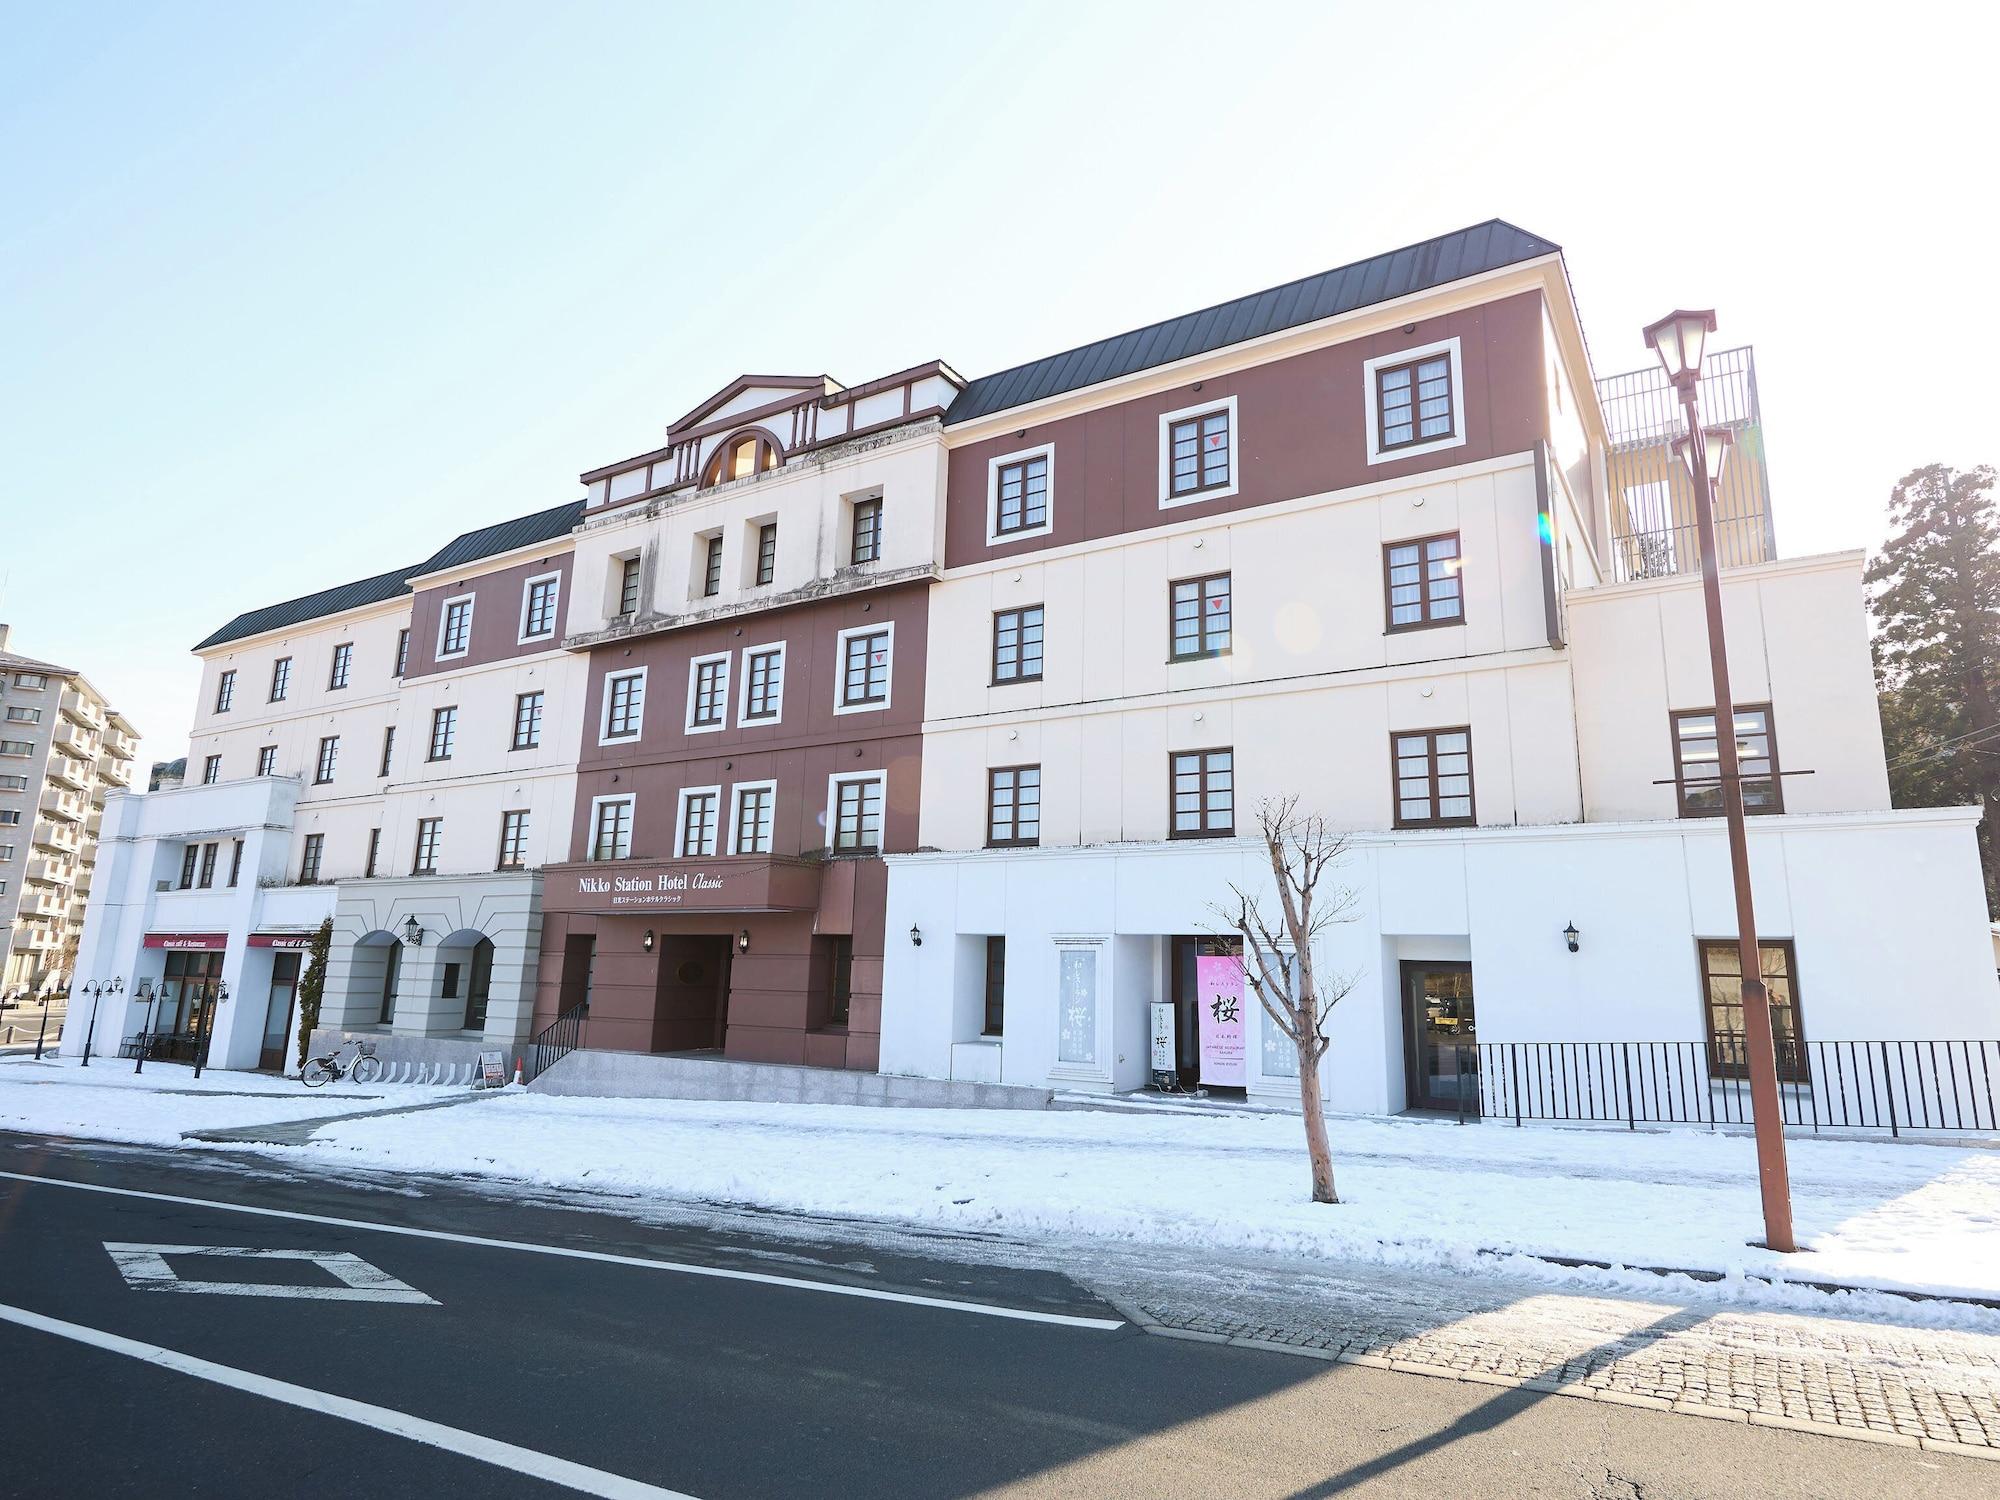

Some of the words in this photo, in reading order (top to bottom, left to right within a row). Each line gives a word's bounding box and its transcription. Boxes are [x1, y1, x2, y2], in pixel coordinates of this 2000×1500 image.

[579, 877, 611, 893] Nikko
[614, 876, 653, 892] Station
[658, 873, 688, 890] Hotel
[691, 872, 724, 889] Classic
[613, 895, 682, 905] 日光ステーションホテルクラシック
[1210, 993, 1240, 1024] 桜
